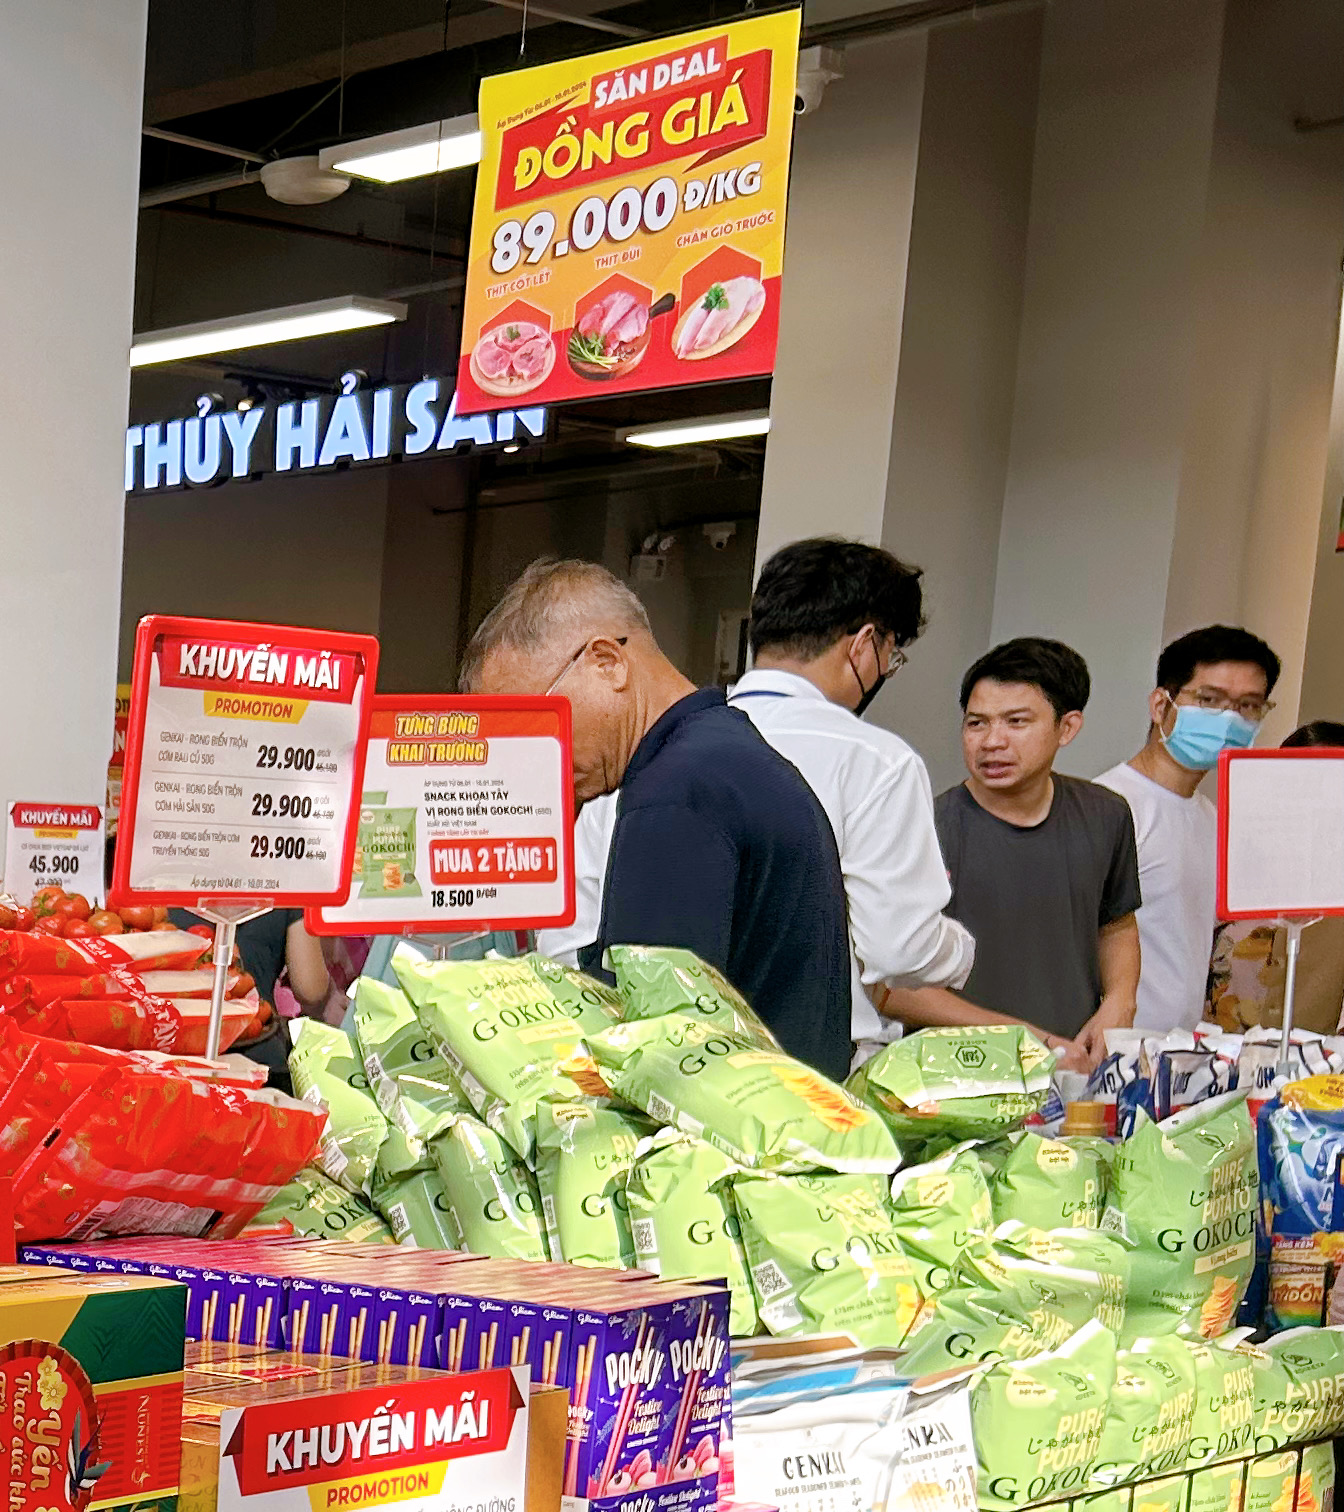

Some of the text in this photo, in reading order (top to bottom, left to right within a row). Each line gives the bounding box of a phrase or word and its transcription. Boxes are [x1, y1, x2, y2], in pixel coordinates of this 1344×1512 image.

[594, 48, 722, 110] SĂN DEAL
[514, 69, 750, 191] ĐỒNG GIÁ
[491, 161, 762, 273] 89.000 Đ/KG
[276, 371, 392, 471] HẢI
[180, 644, 340, 690] KHUYẾN MÃI
[215, 698, 293, 718] PROMOTION
[256, 745, 314, 771] 29.900
[390, 743, 424, 762] KHAI
[252, 793, 311, 818] 29.900
[29, 855, 79, 874] 45.900
[250, 835, 304, 859] 29.900
[434, 843, 553, 880] MUA 2 TẶNG 1
[431, 890, 473, 908] 18.500
[606, 1341, 666, 1395] POCKY
[266, 1391, 489, 1474] KHUYẾN MÃI
[327, 1472, 429, 1508] PROMOTION
